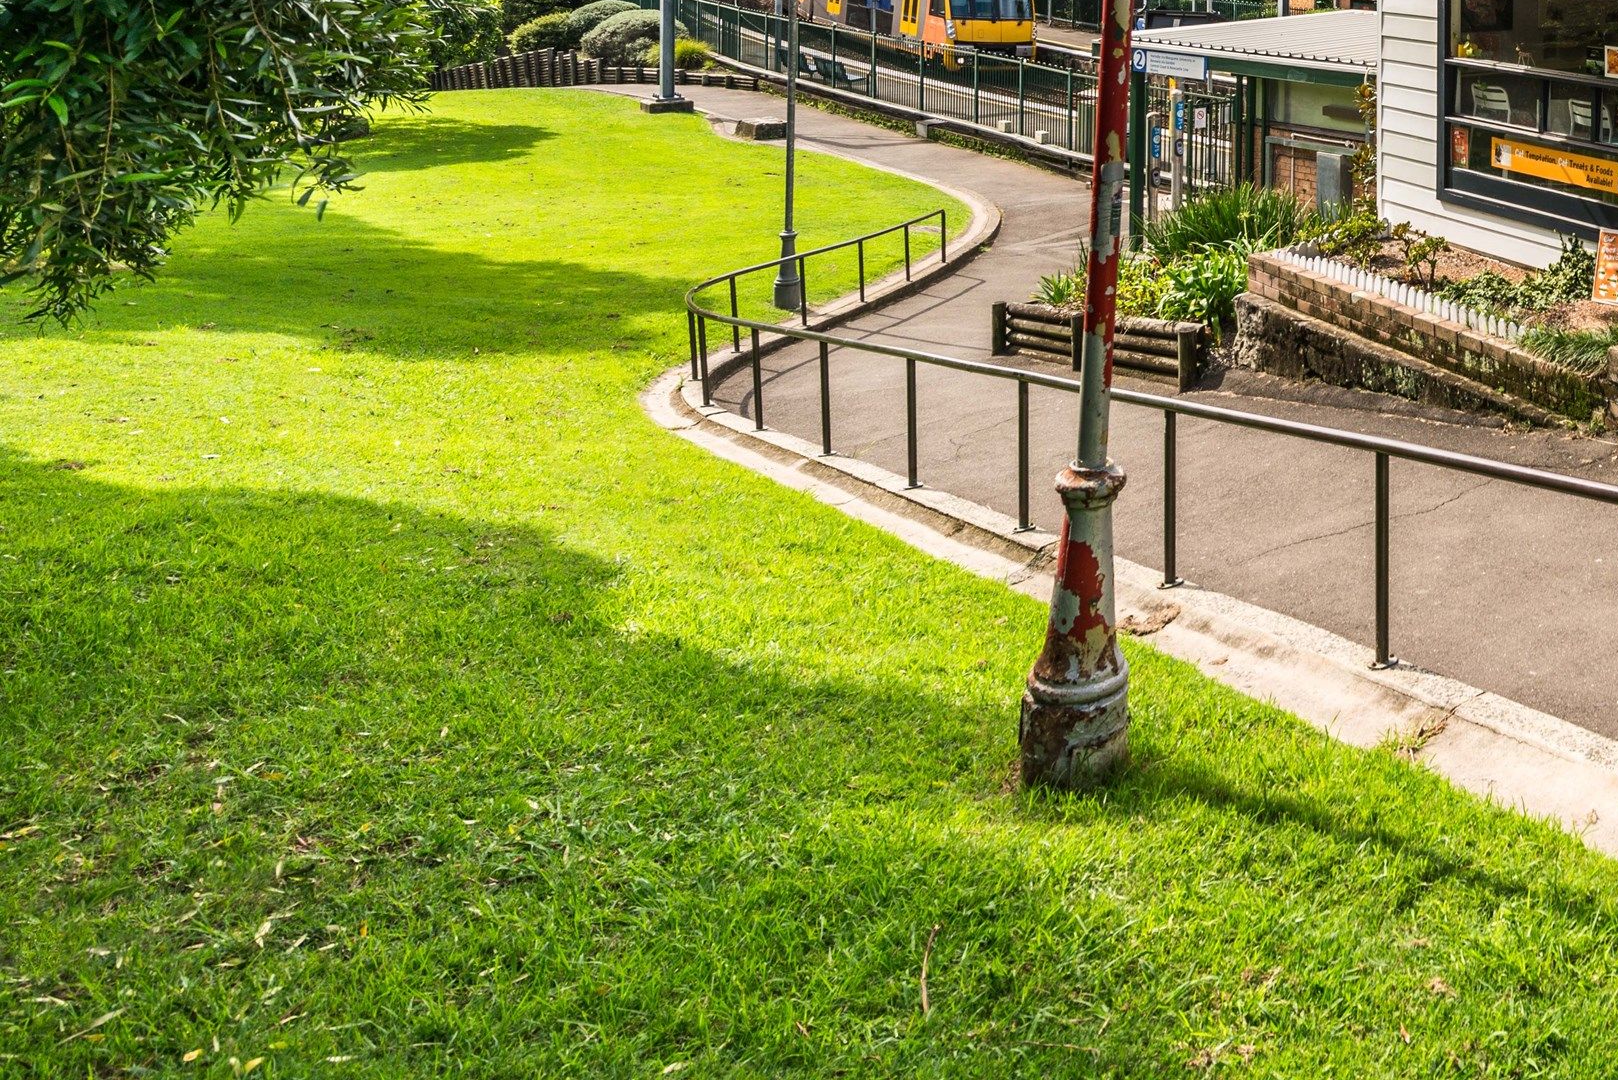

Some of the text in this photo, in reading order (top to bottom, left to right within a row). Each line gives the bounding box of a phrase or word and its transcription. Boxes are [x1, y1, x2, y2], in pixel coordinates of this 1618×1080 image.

[1136, 51, 1143, 67] 2
[1515, 148, 1524, 157] Cat
[1558, 157, 1568, 167] Cat
[1569, 159, 1588, 172] Treats
[1590, 164, 1595, 173] &
[1596, 165, 1613, 176] Foods
[1586, 174, 1613, 187] Available!
